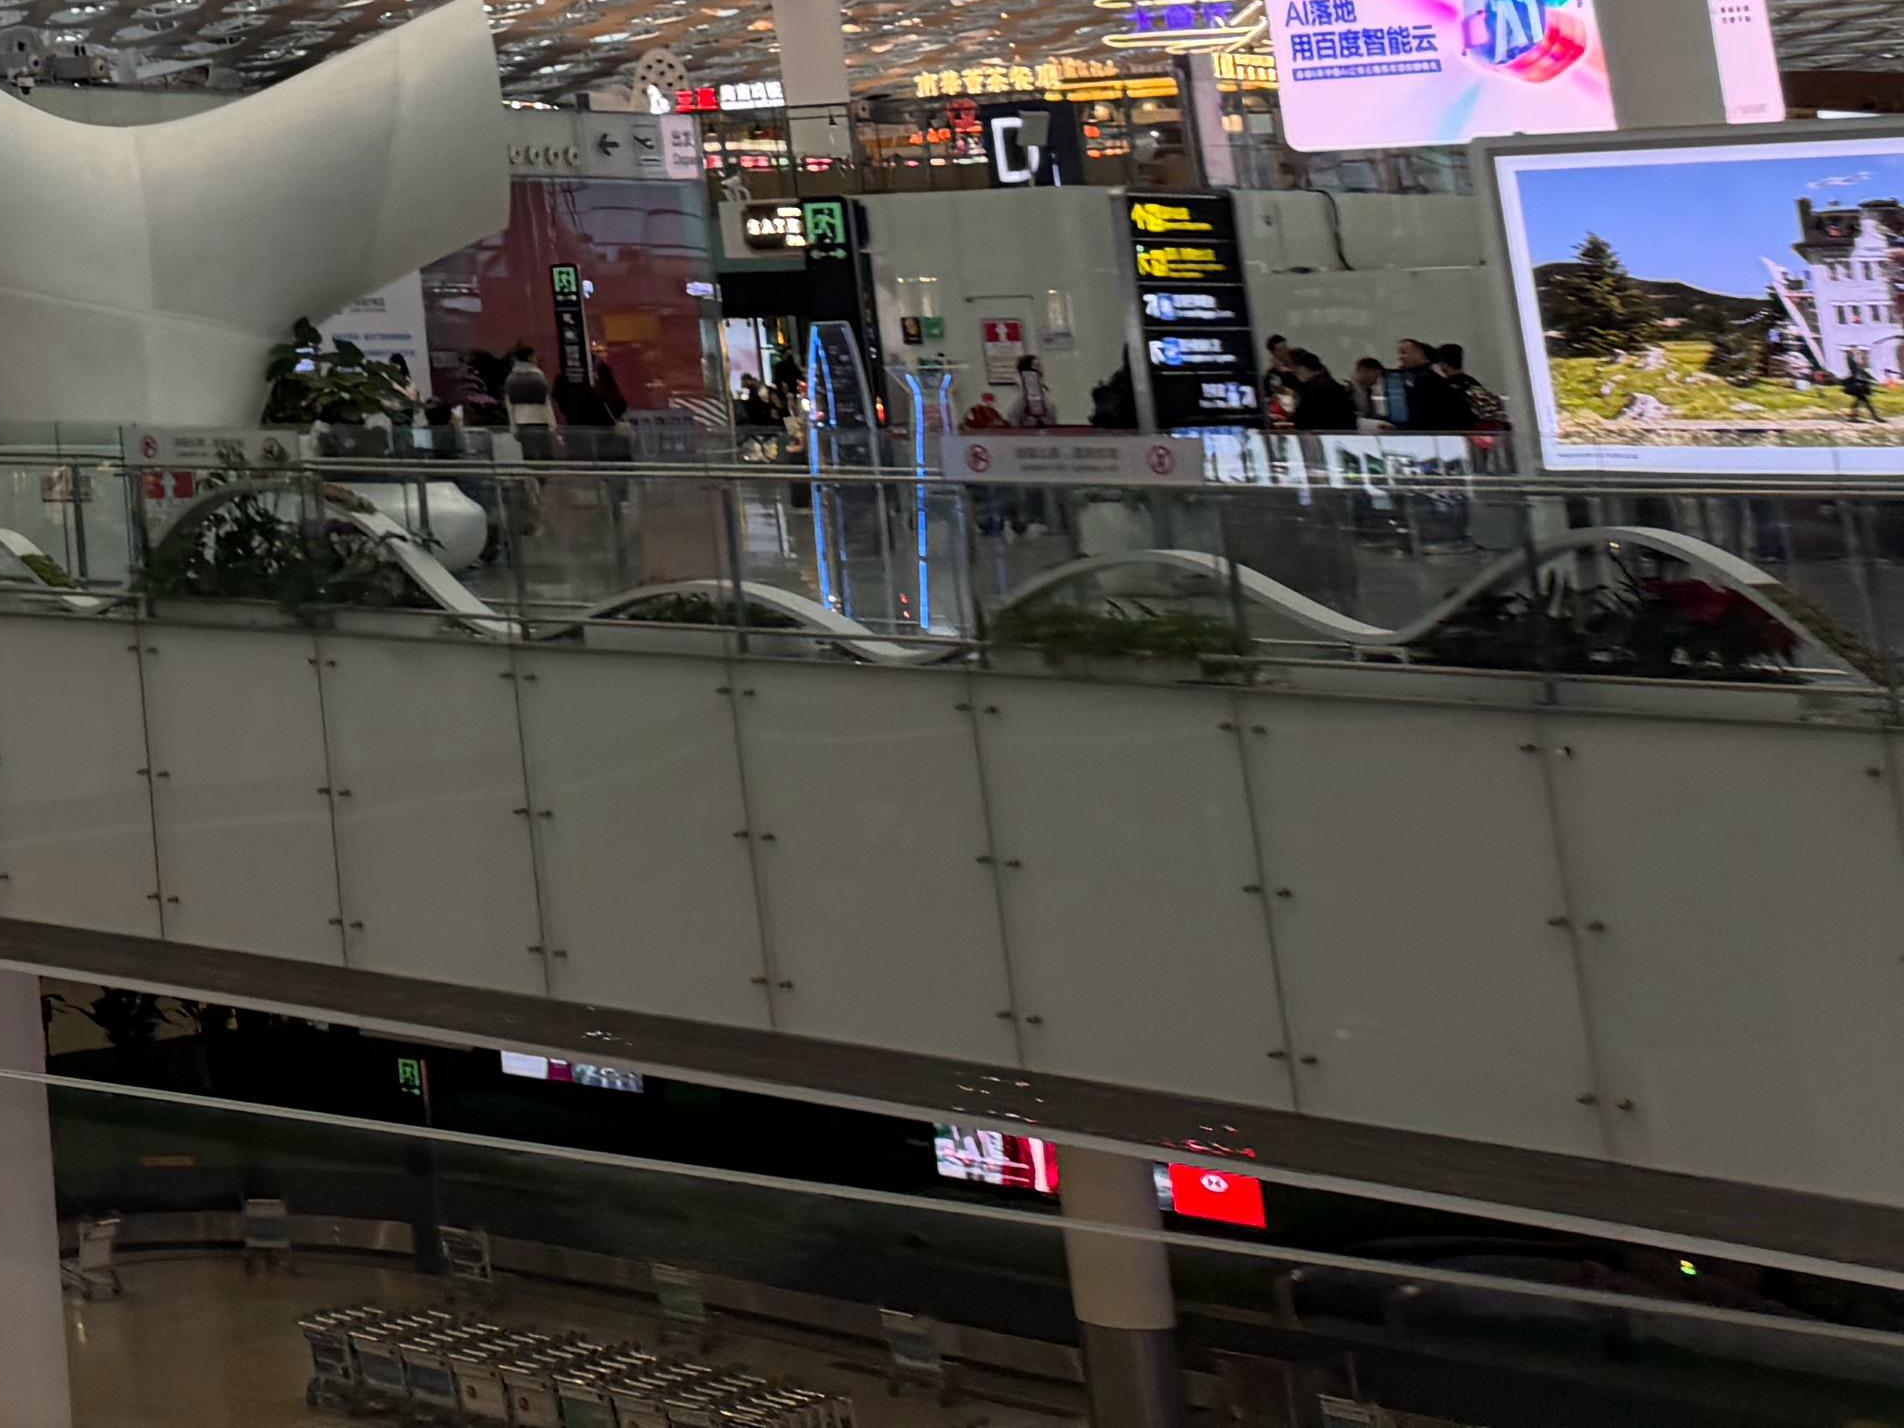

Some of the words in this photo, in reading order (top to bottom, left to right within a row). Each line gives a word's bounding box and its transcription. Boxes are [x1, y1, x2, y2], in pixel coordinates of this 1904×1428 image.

[1290, 25, 1439, 63] 用百度智能云
